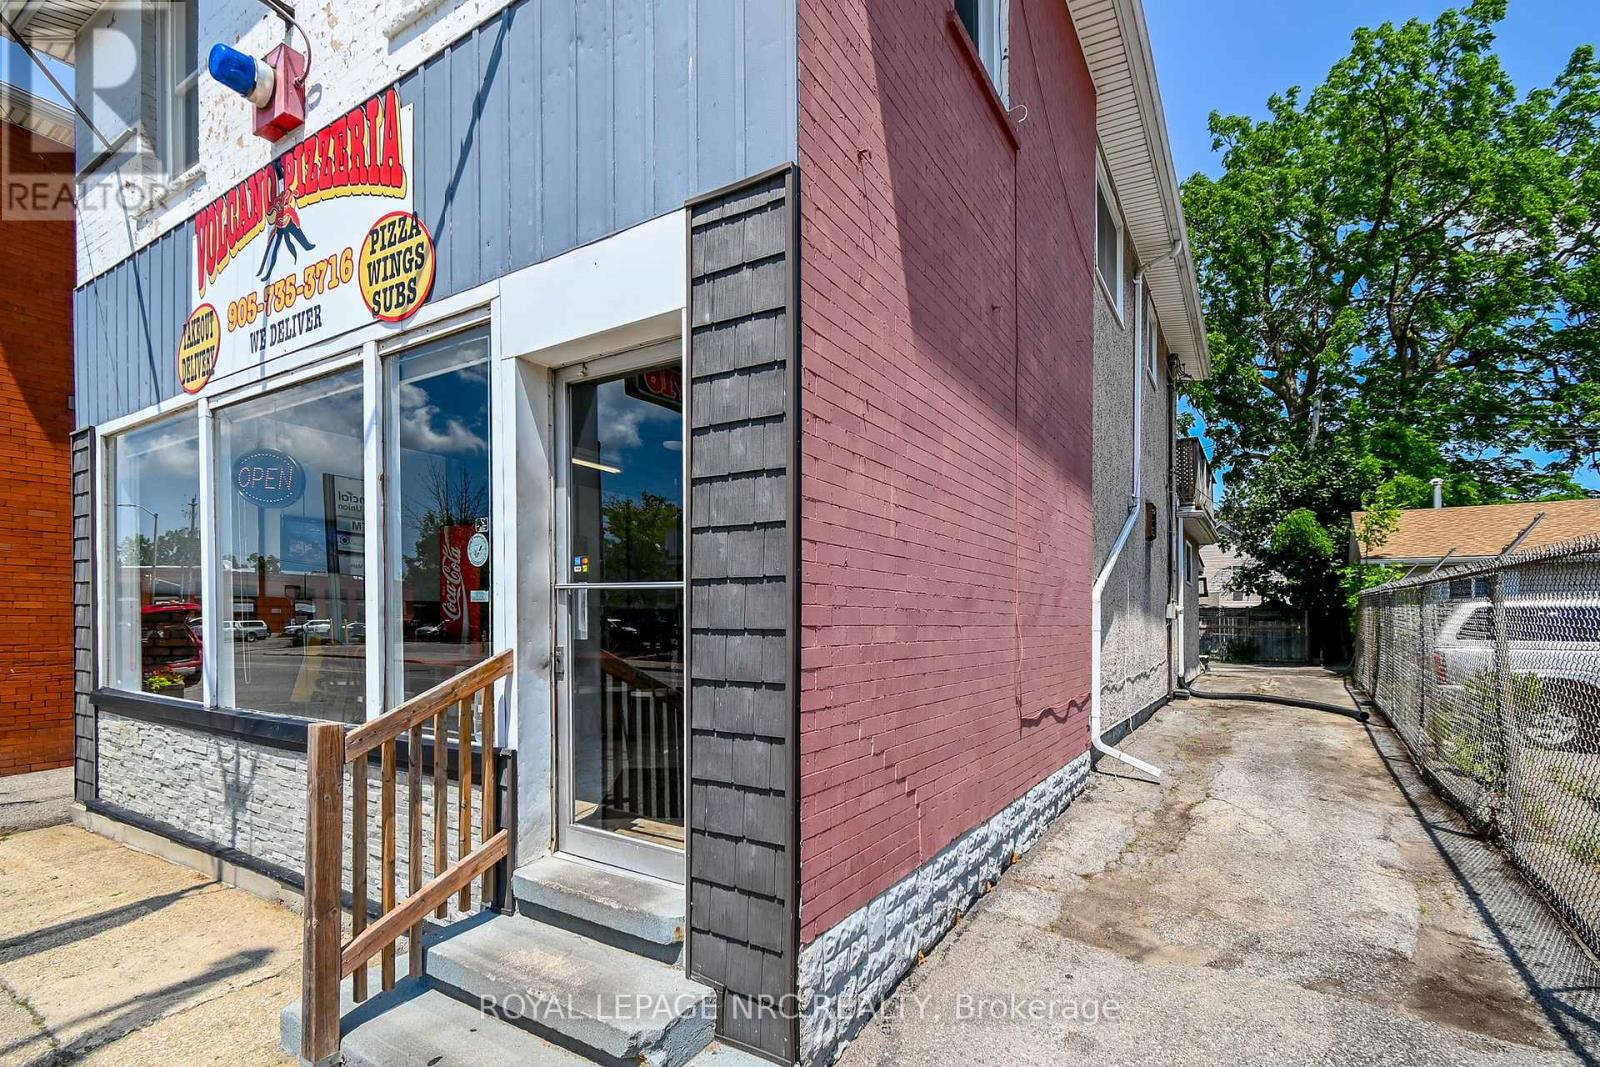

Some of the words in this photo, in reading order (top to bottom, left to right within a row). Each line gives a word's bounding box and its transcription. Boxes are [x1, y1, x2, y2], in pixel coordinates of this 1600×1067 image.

[194, 163, 278, 299] VOLCANO
[280, 87, 408, 210] PIZZERIA
[369, 211, 422, 256] PIZZA
[367, 241, 425, 287] WINGS
[227, 246, 354, 333] 905-735-3716
[372, 276, 417, 318] SUBS
[183, 311, 214, 350] TAKEOUT
[250, 327, 267, 353] WE
[270, 304, 323, 346] DELIVER
[181, 345, 215, 385] DELIVERY
[237, 466, 294, 491] OPEN
